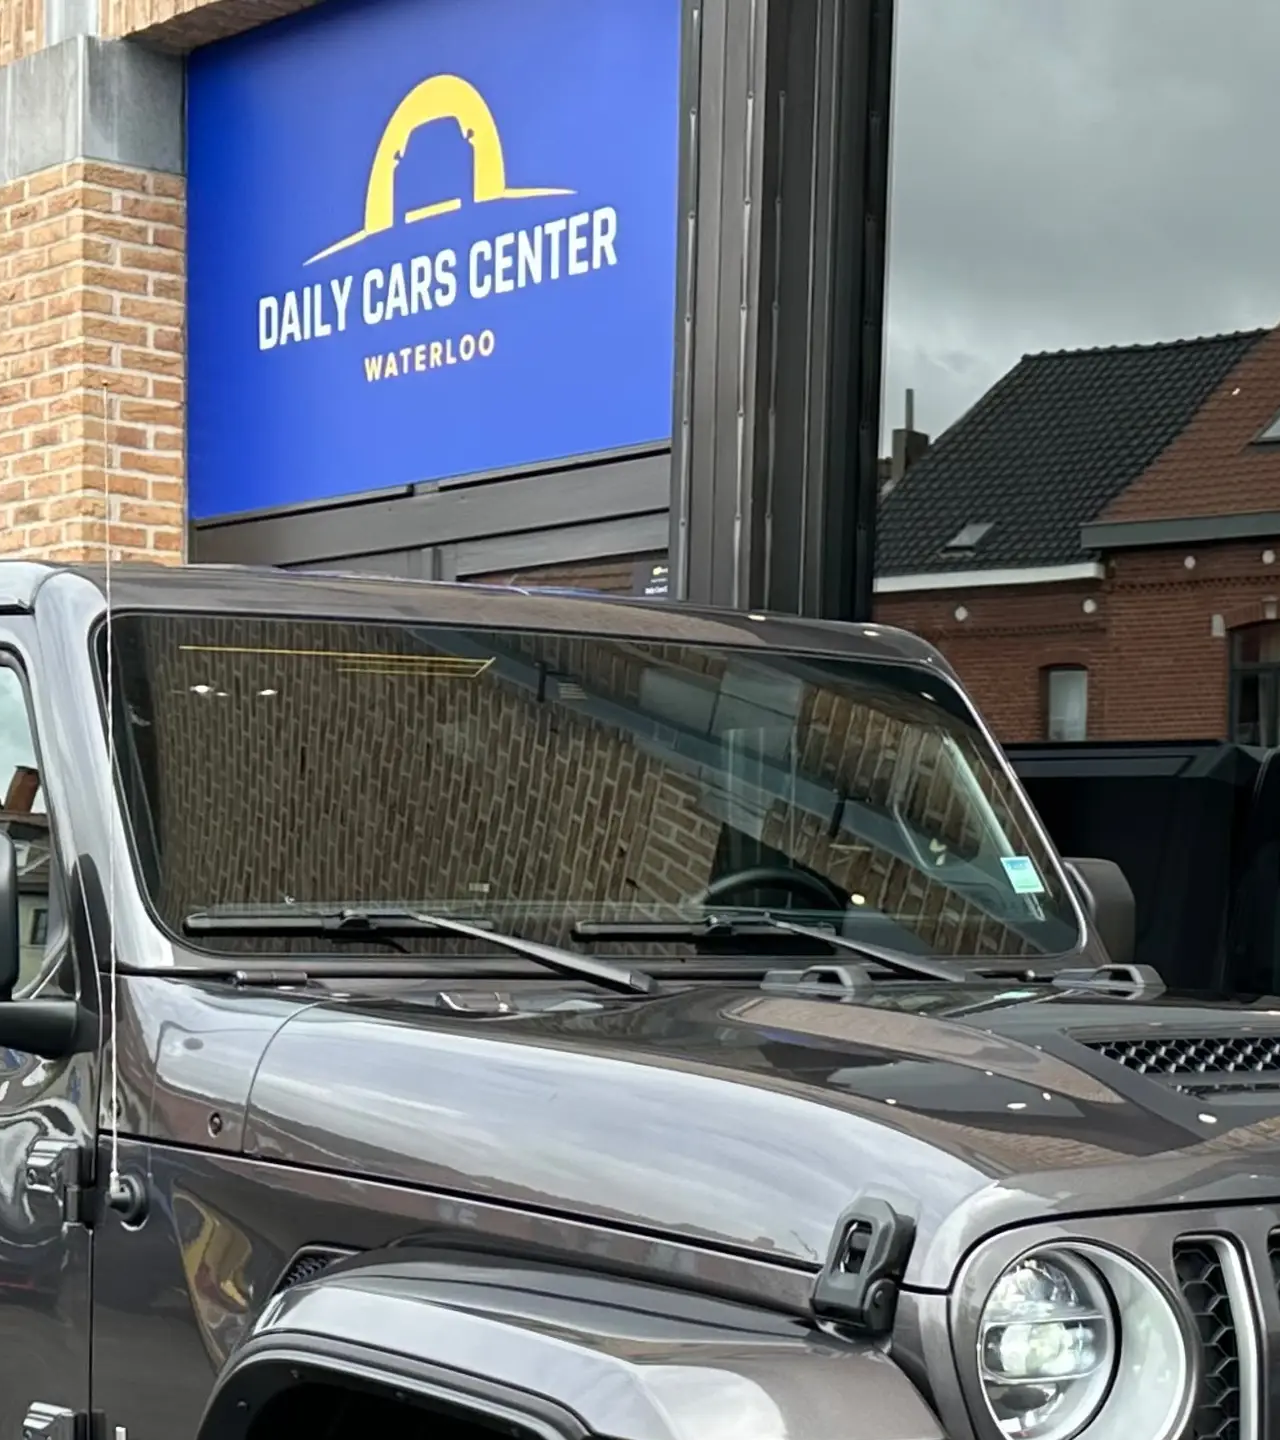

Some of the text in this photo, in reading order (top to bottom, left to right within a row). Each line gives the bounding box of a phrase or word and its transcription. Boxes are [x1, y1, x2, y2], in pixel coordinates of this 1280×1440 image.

[258, 206, 617, 350] DAILY CARS CENTER
[364, 329, 496, 383] WATERLOO
